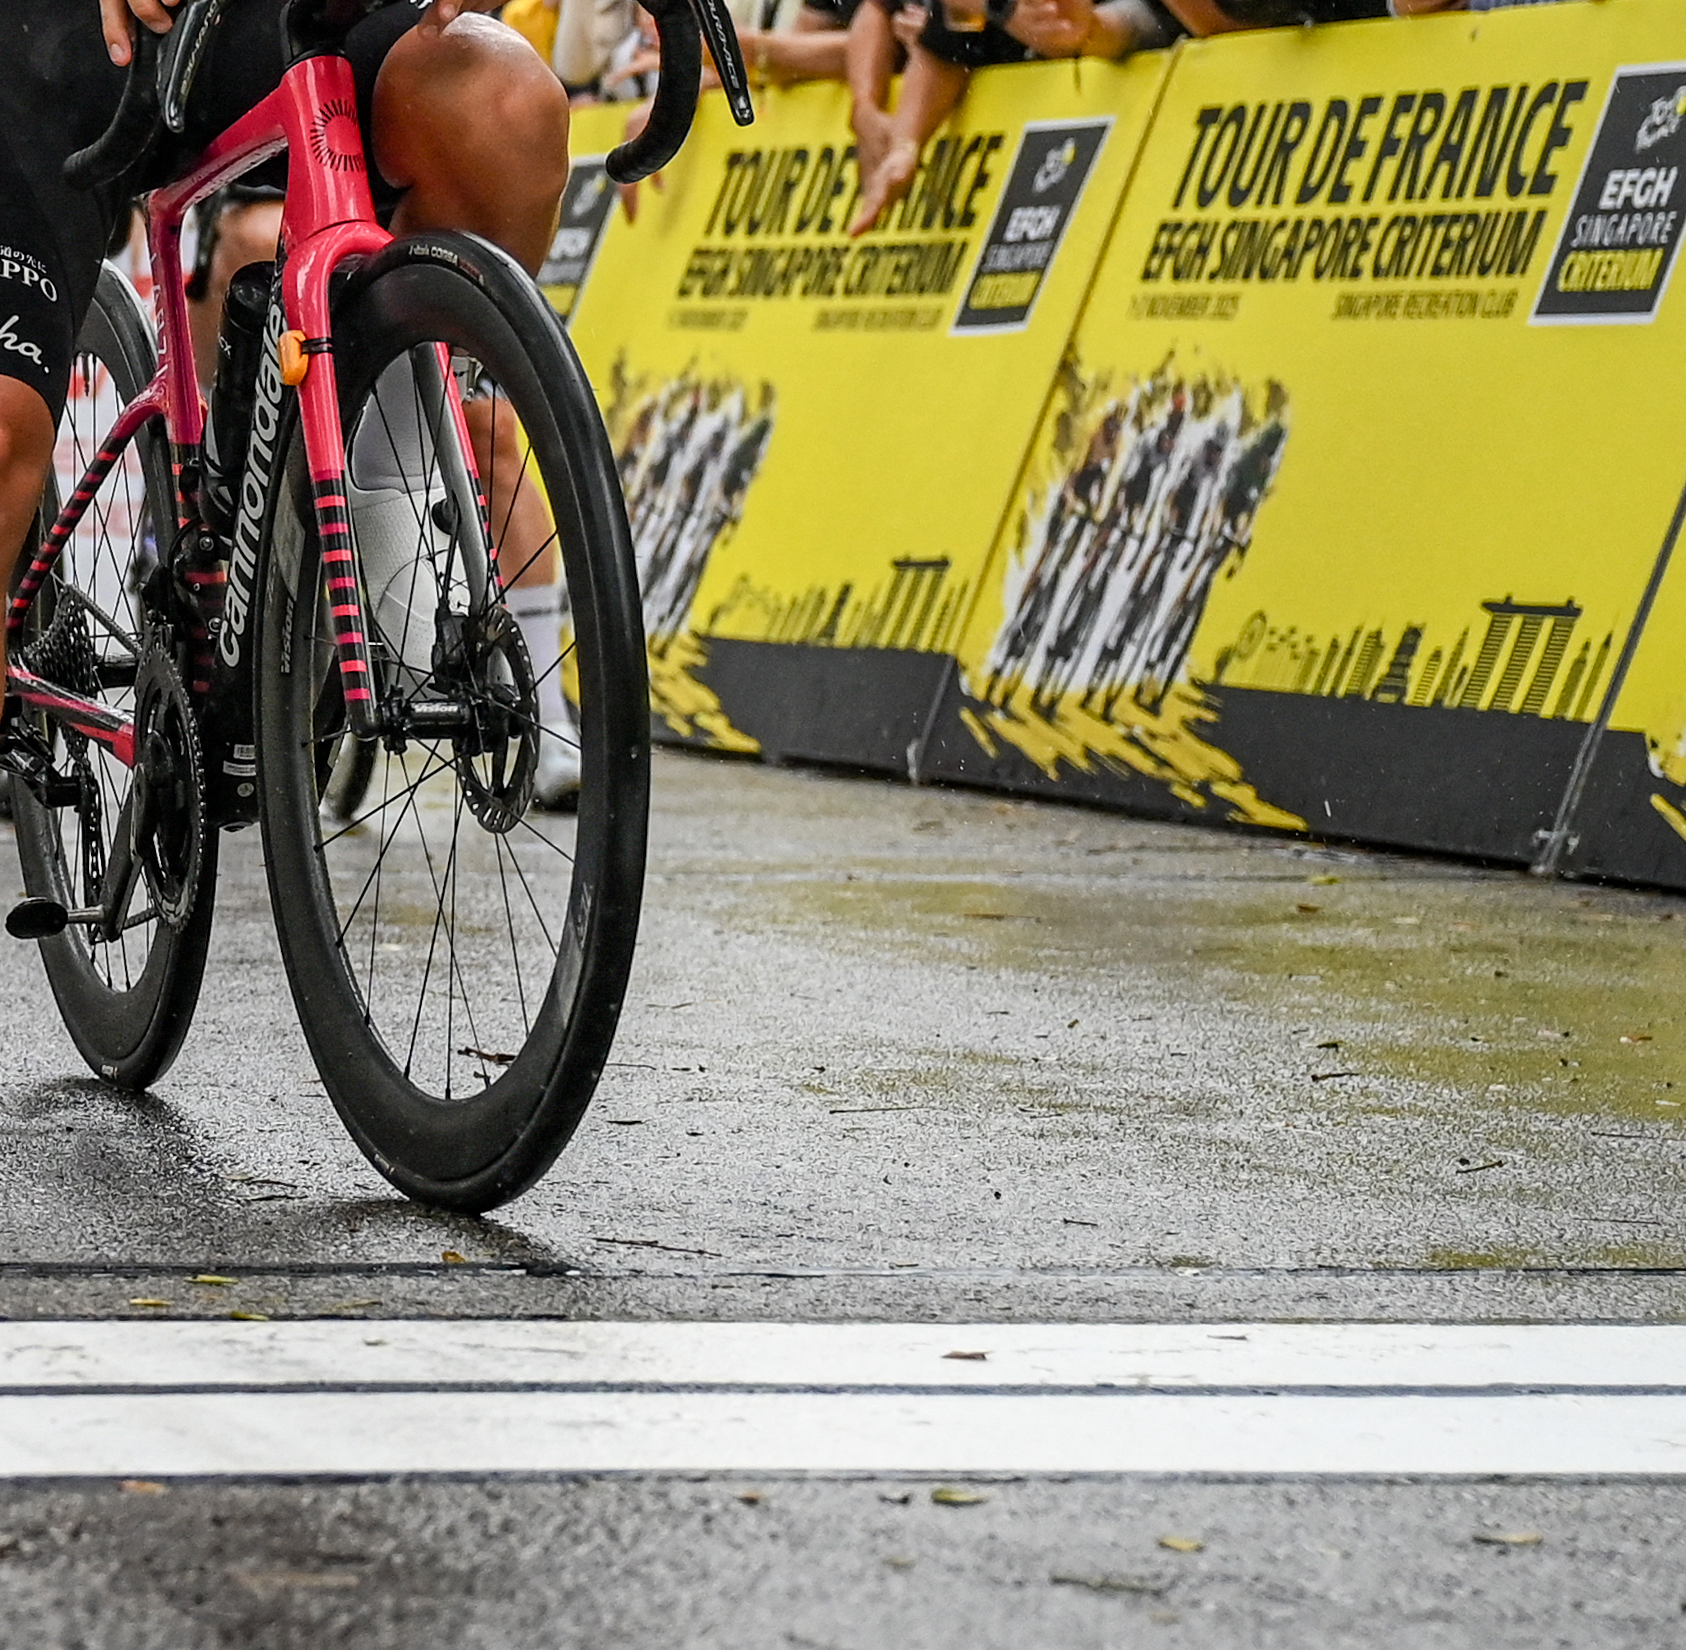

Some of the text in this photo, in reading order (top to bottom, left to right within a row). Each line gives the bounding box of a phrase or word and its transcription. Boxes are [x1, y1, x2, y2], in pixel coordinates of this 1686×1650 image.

[1173, 99, 1314, 211] TOUR
[1294, 94, 1384, 206] DE
[1360, 80, 1591, 204] FRANCE
[704, 147, 810, 237] TOUR
[1597, 166, 1679, 212] EFGH
[1141, 208, 1547, 282] EFGH SINGAPORE CRITERIUM
[1568, 209, 1677, 249] SINGAPORE
[1555, 247, 1665, 293] CRITERIUM
[219, 302, 288, 668] cannondale
